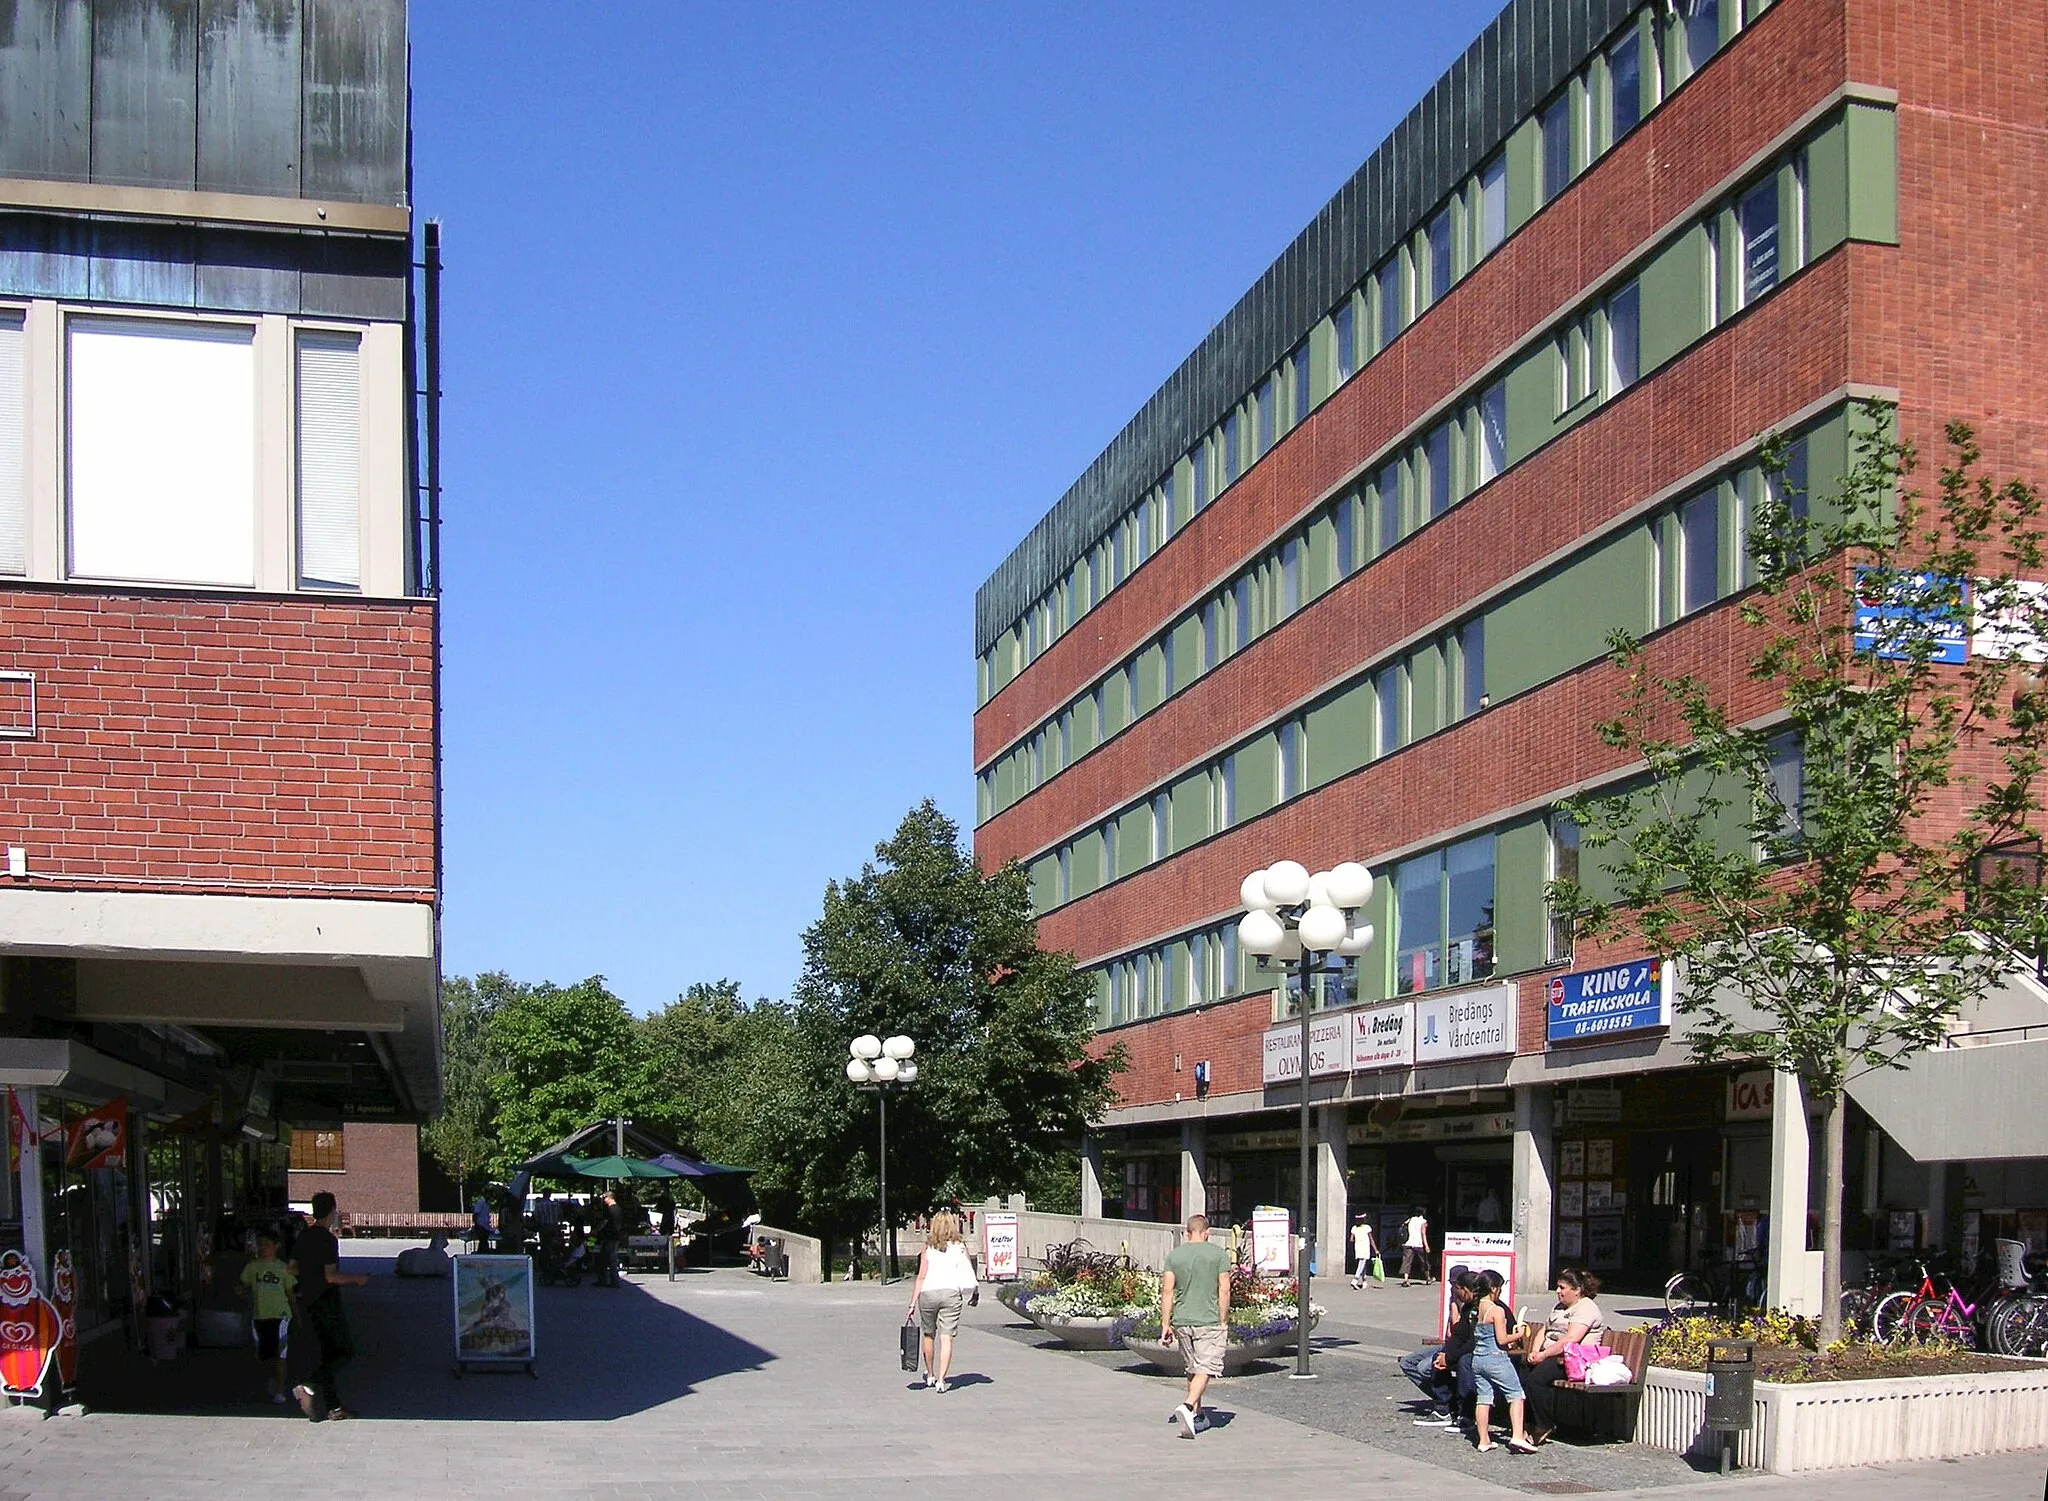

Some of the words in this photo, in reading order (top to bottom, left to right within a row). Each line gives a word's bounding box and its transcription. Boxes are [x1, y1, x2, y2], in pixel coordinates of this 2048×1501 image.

[1581, 967, 1631, 997] KING
[1449, 1002, 1494, 1023] Bredängs
[1561, 990, 1650, 1018] TRAFIKSKOLA
[1372, 1013, 1404, 1036] Bredäng
[1449, 1022, 1504, 1048] Vårdcentral
[1265, 1033, 1302, 1052] RESTAURAN
[1310, 1025, 1341, 1043] PIZZERIA
[1279, 1051, 1325, 1076] OLYMOS
[1732, 1083, 1761, 1111] ICA
